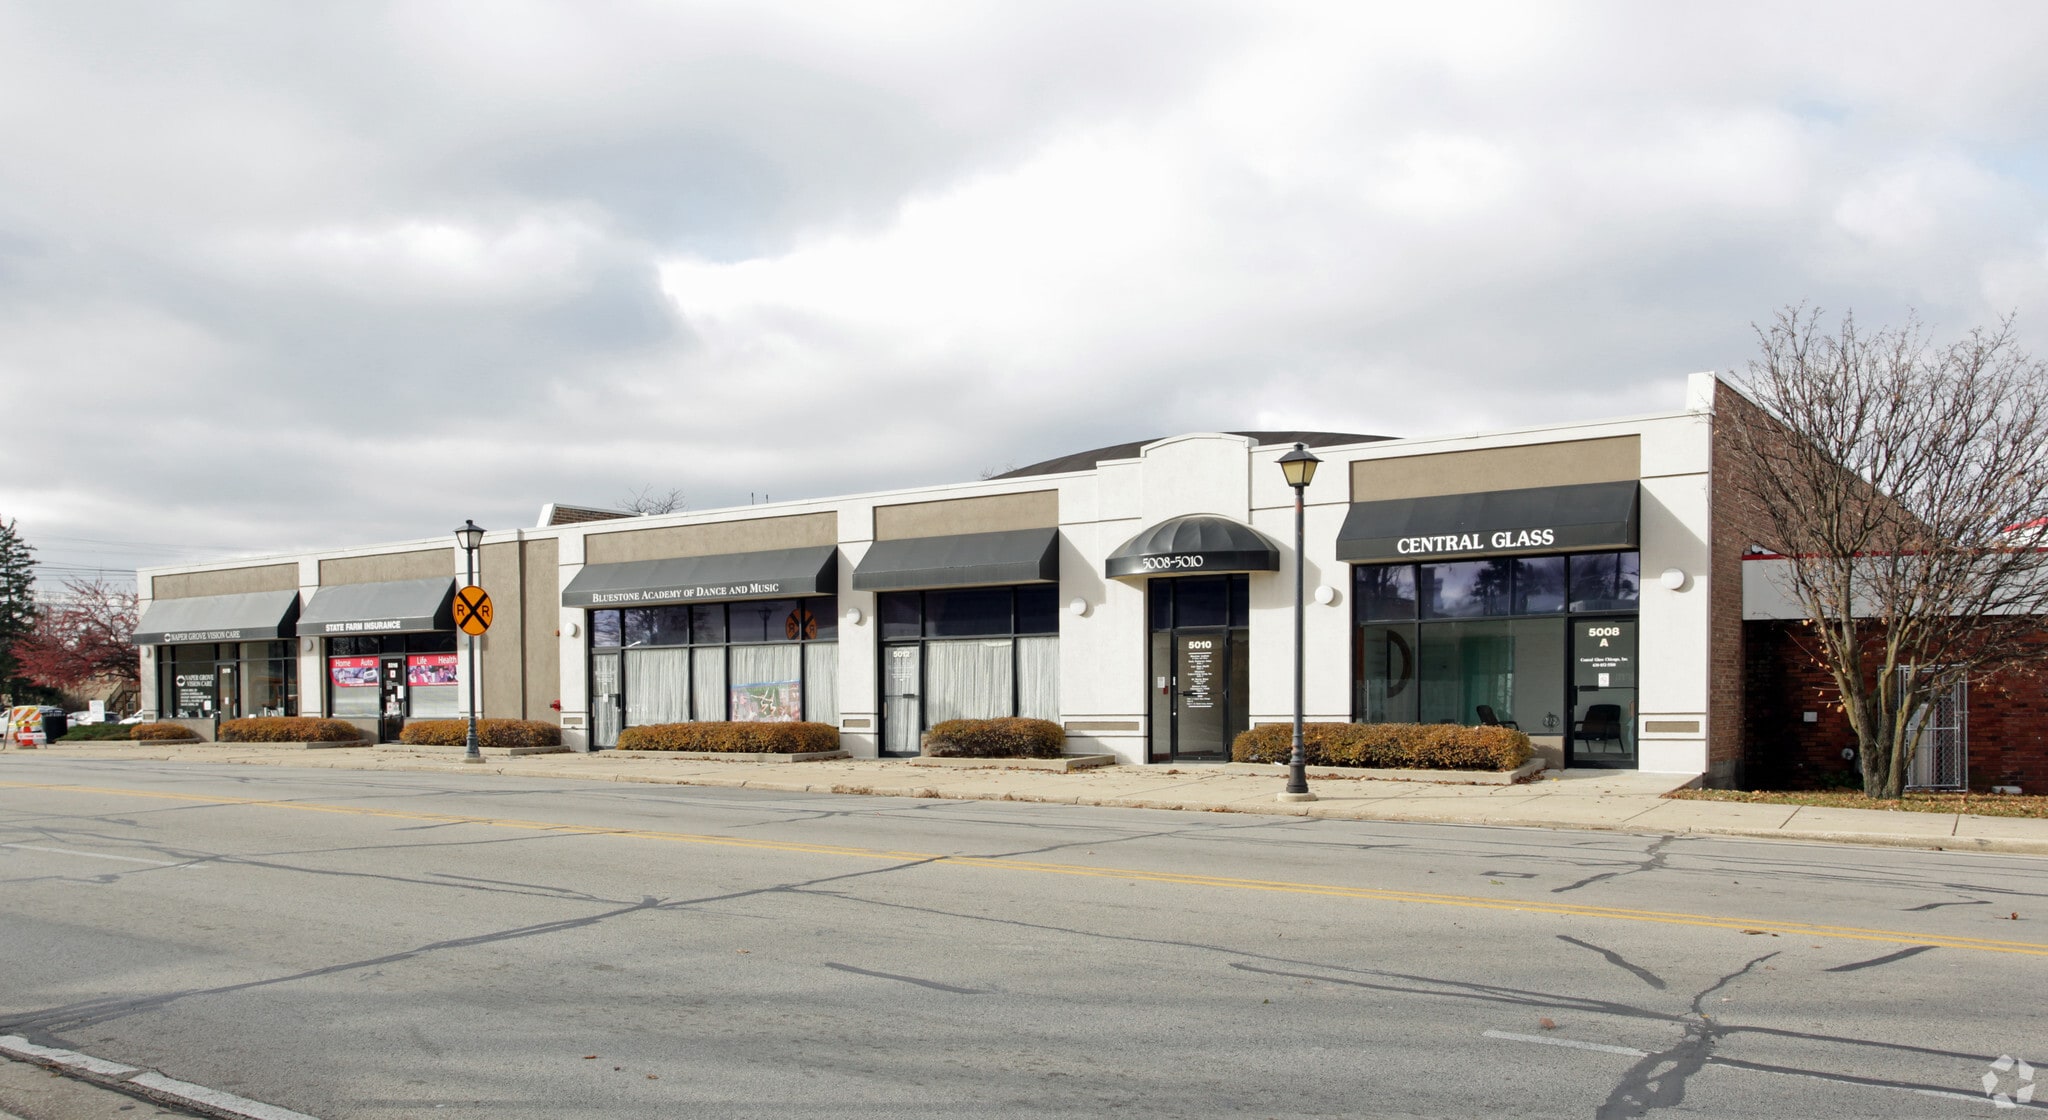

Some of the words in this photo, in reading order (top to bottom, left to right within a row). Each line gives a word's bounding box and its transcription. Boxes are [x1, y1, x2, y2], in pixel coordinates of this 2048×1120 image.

[1397, 533, 1484, 554] CENTRAL
[1491, 528, 1554, 548] GLASS
[1142, 555, 1204, 570] 5008-5010
[456, 603, 465, 617] R
[481, 605, 490, 617] R
[325, 623, 345, 632] STATE
[345, 622, 363, 631] FARM
[364, 620, 401, 630] INSURANCE
[171, 632, 188, 641] NAPER
[188, 631, 207, 640] GROVE
[207, 630, 225, 639] VISION
[225, 630, 241, 639] CARE
[1588, 627, 1620, 637] 5008
[1188, 640, 1212, 649] 5010
[1599, 638, 1609, 647] A
[893, 650, 910, 658] 5012
[335, 659, 351, 667] Home
[360, 658, 374, 666] Auto
[416, 656, 428, 665] Life
[438, 655, 457, 664] Health
